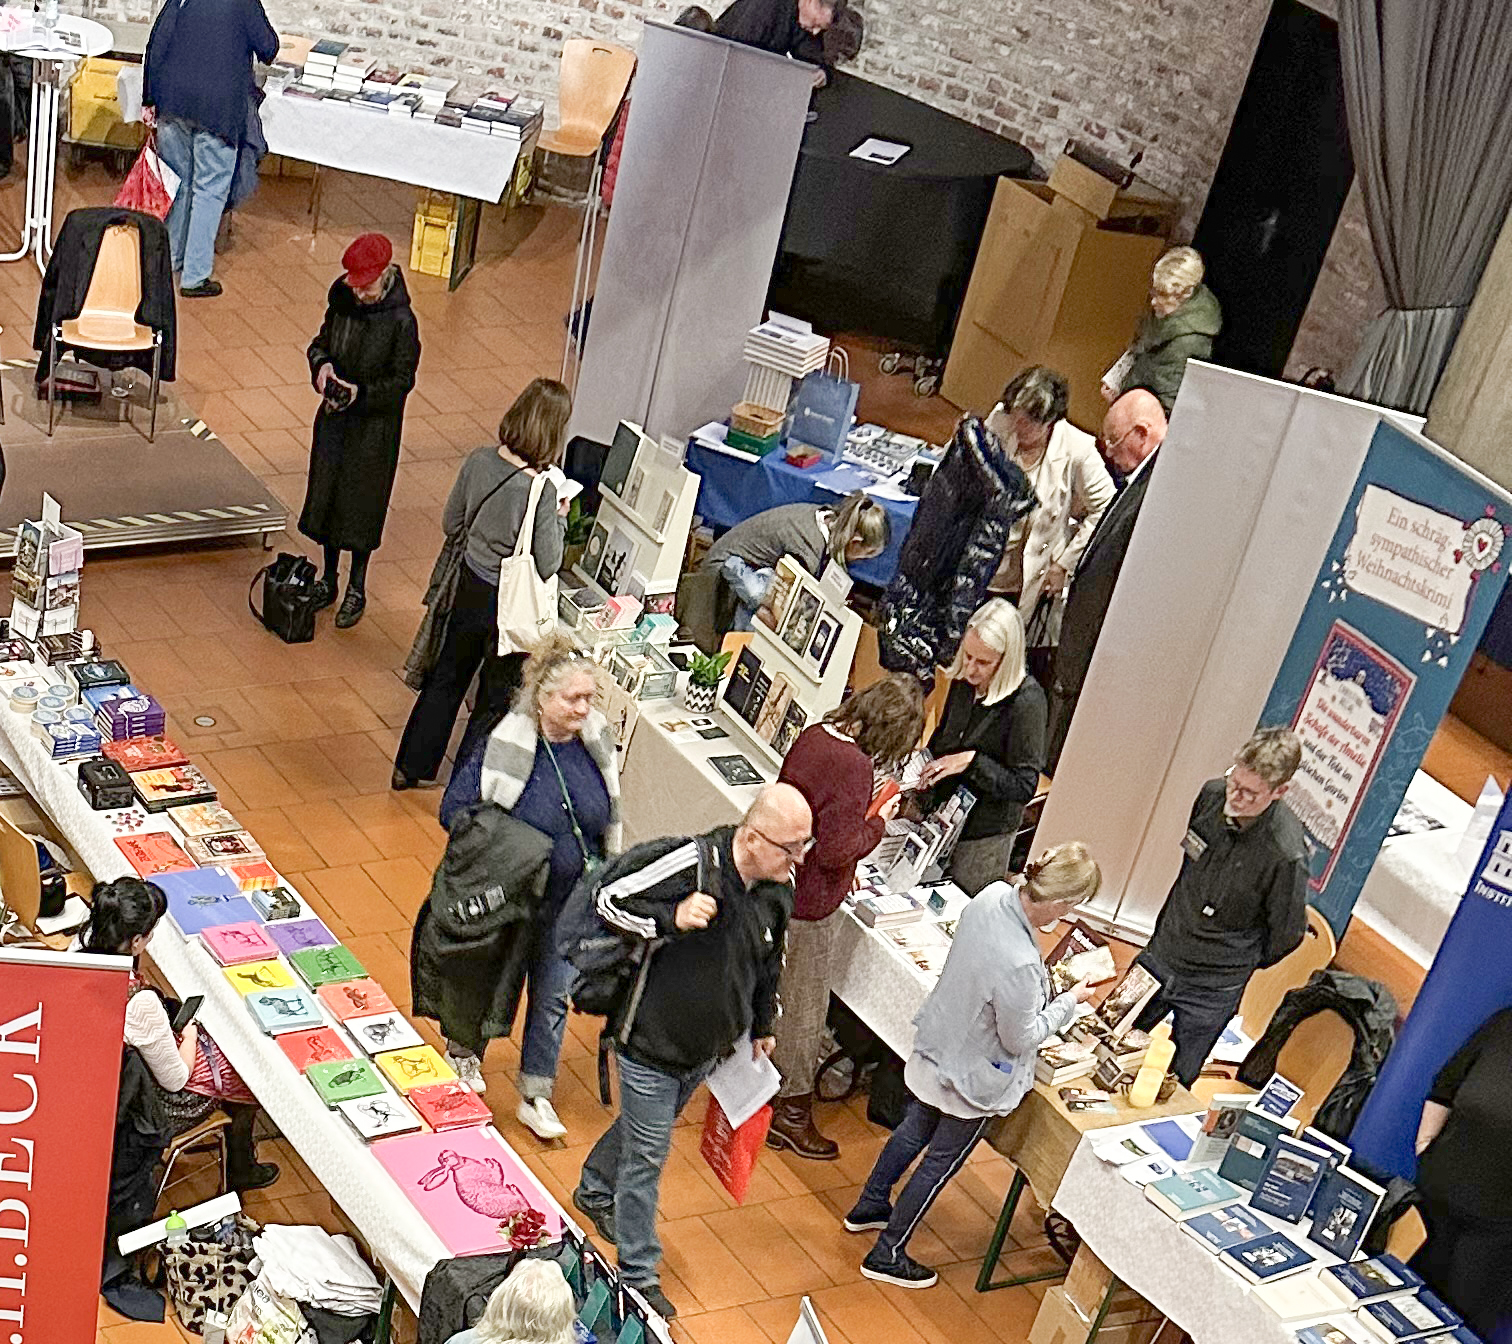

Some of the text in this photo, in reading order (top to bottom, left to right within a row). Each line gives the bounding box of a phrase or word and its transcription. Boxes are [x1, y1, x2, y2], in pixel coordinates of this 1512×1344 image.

[1386, 506, 1408, 530] Ein
[1369, 532, 1455, 580] sympathischer
[1355, 551, 1453, 610] Weihnachtskrimi
